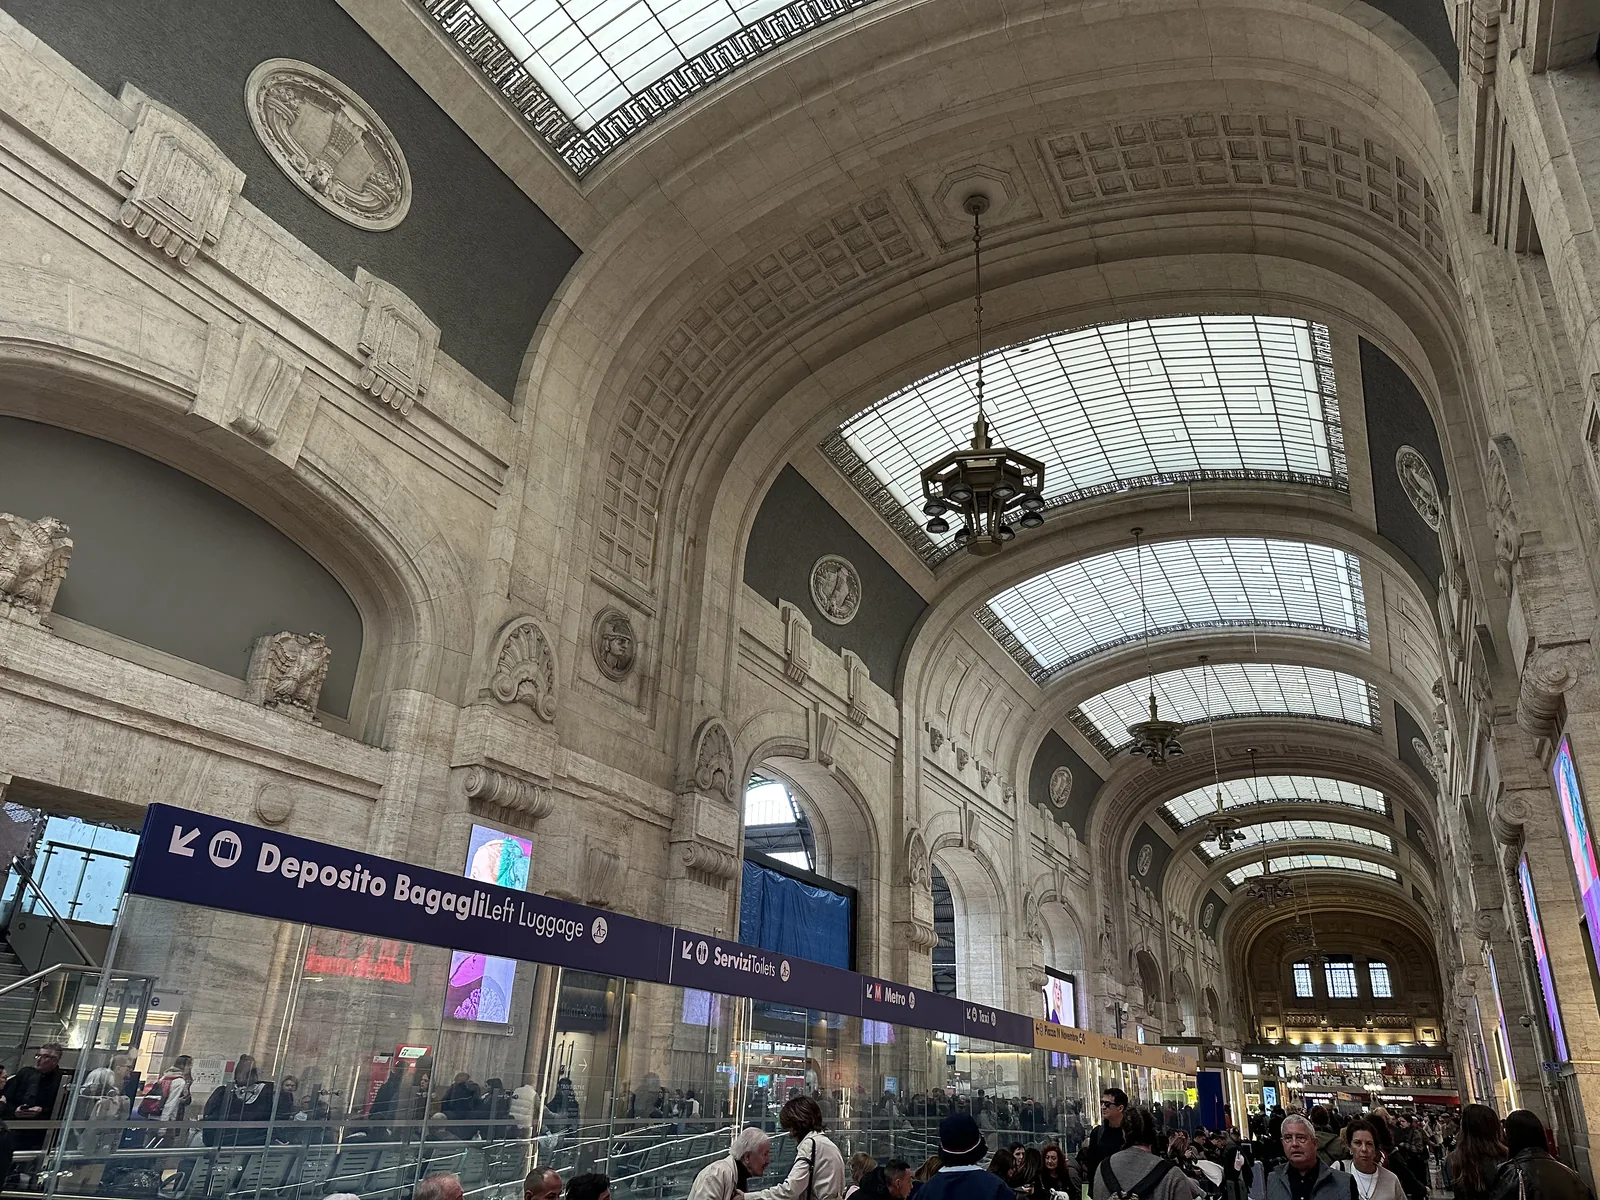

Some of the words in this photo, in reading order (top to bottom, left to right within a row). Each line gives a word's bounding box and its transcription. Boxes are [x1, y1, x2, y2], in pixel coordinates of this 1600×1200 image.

[256, 842, 386, 897] Deposito
[394, 873, 485, 921] Bagagli
[485, 897, 514, 923] Left
[519, 902, 583, 941] Luggage
[713, 946, 751, 972] Servizi
[751, 955, 776, 977] Toilets
[884, 986, 906, 1006] Metro
[978, 1009, 990, 1024] Taxi
